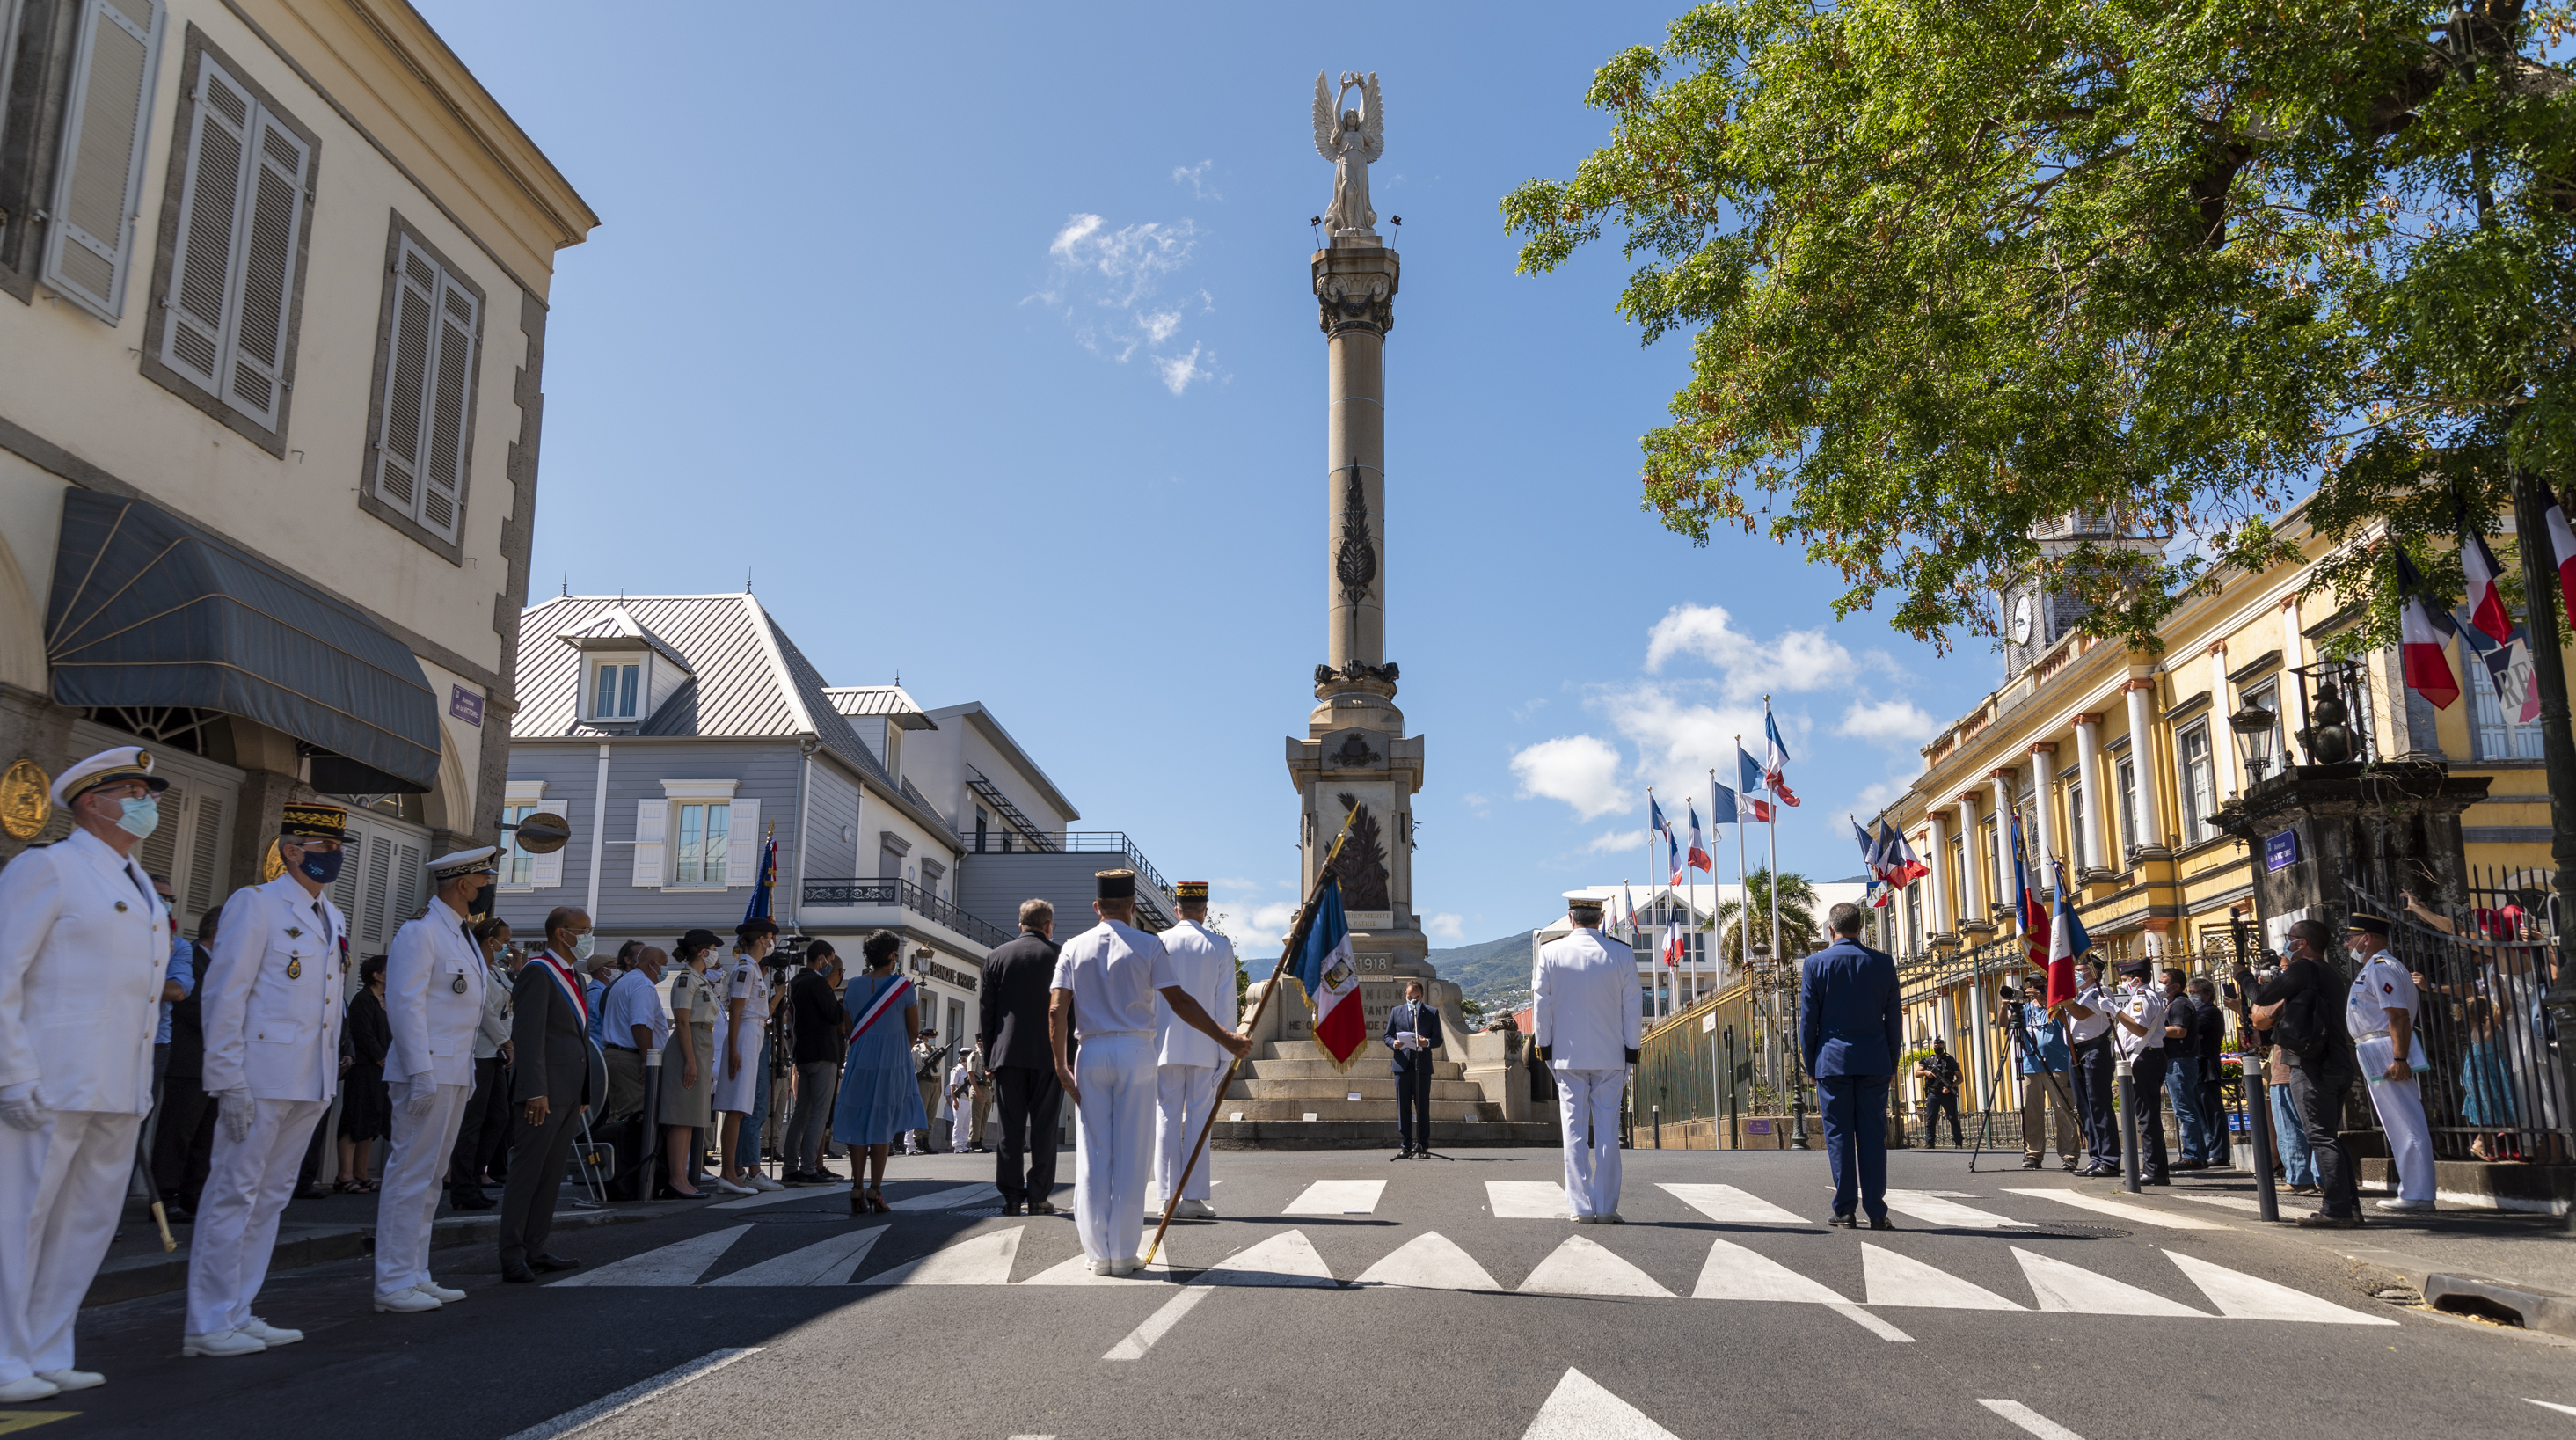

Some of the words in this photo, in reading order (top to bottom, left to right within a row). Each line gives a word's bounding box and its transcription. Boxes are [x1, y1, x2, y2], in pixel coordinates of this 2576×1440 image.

[2493, 661, 2533, 710] RF
[462, 697, 474, 706] Avenue
[463, 706, 478, 719] VICTOIRE
[2274, 842, 2285, 851] Avenue
[1869, 888, 1885, 900] RF
[524, 941, 546, 952] PRI
[1359, 958, 1387, 971] 1918
[930, 962, 957, 984] BANQUE
[1366, 989, 1402, 1000] NION
[1289, 1020, 1312, 1030] HERO
